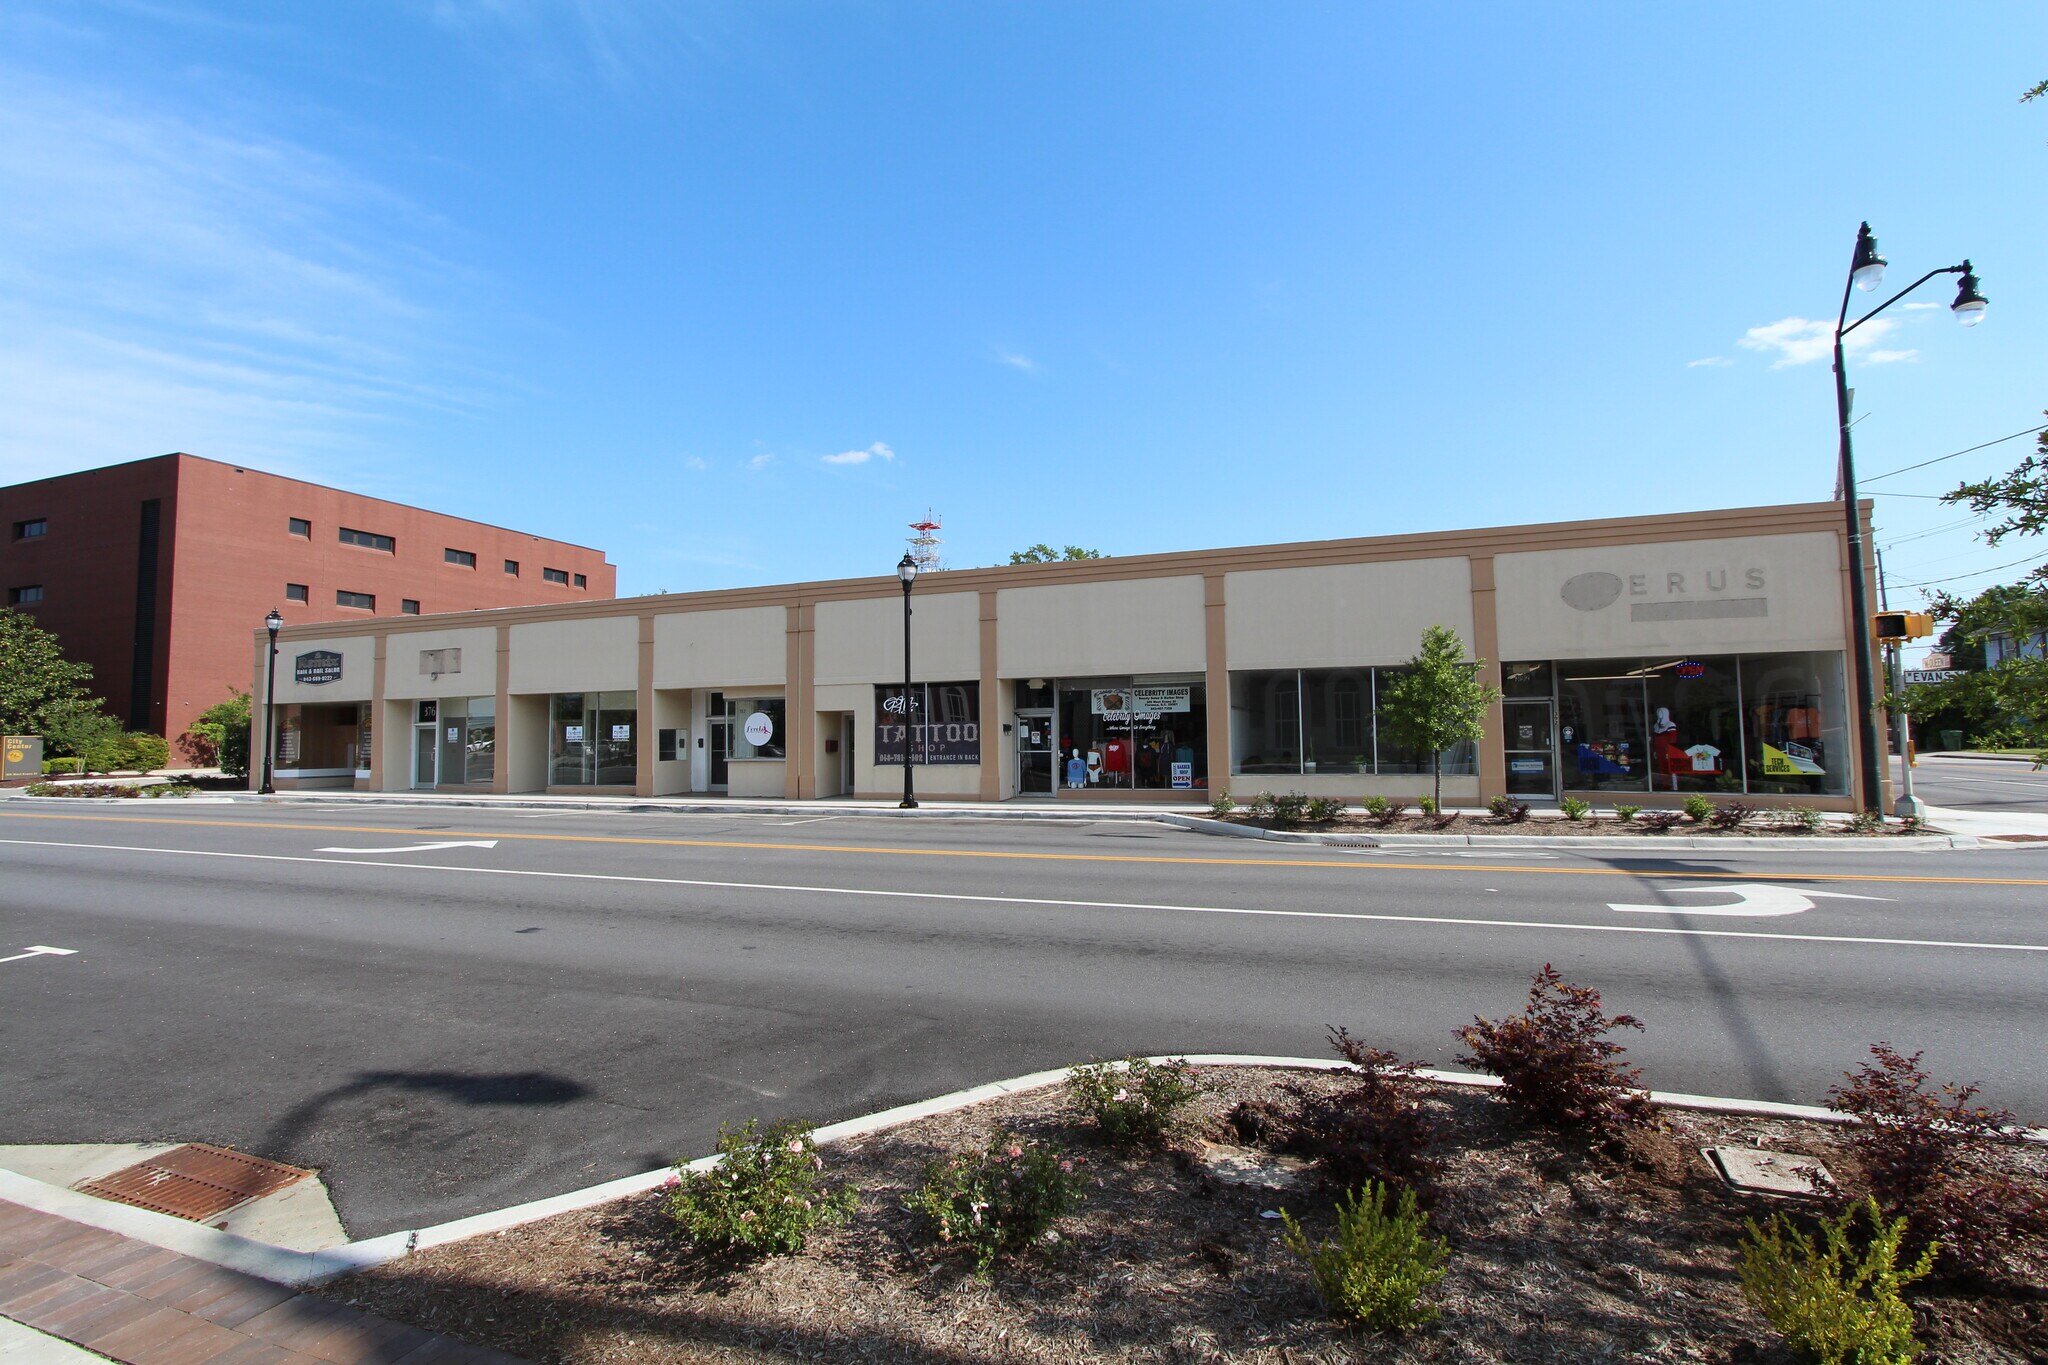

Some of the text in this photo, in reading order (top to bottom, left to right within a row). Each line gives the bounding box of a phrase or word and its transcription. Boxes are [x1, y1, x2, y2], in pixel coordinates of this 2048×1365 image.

[1629, 567, 1766, 596] ERUS
[1675, 665, 1704, 675] OPEN
[1913, 671, 1950, 682] EVANS
[1134, 688, 1189, 697] CELEBRITY IMAGES
[424, 706, 436, 717] 376
[1103, 710, 1161, 725] Celebrity Images
[878, 723, 978, 743] TATTOO
[910, 744, 946, 752] SHOP
